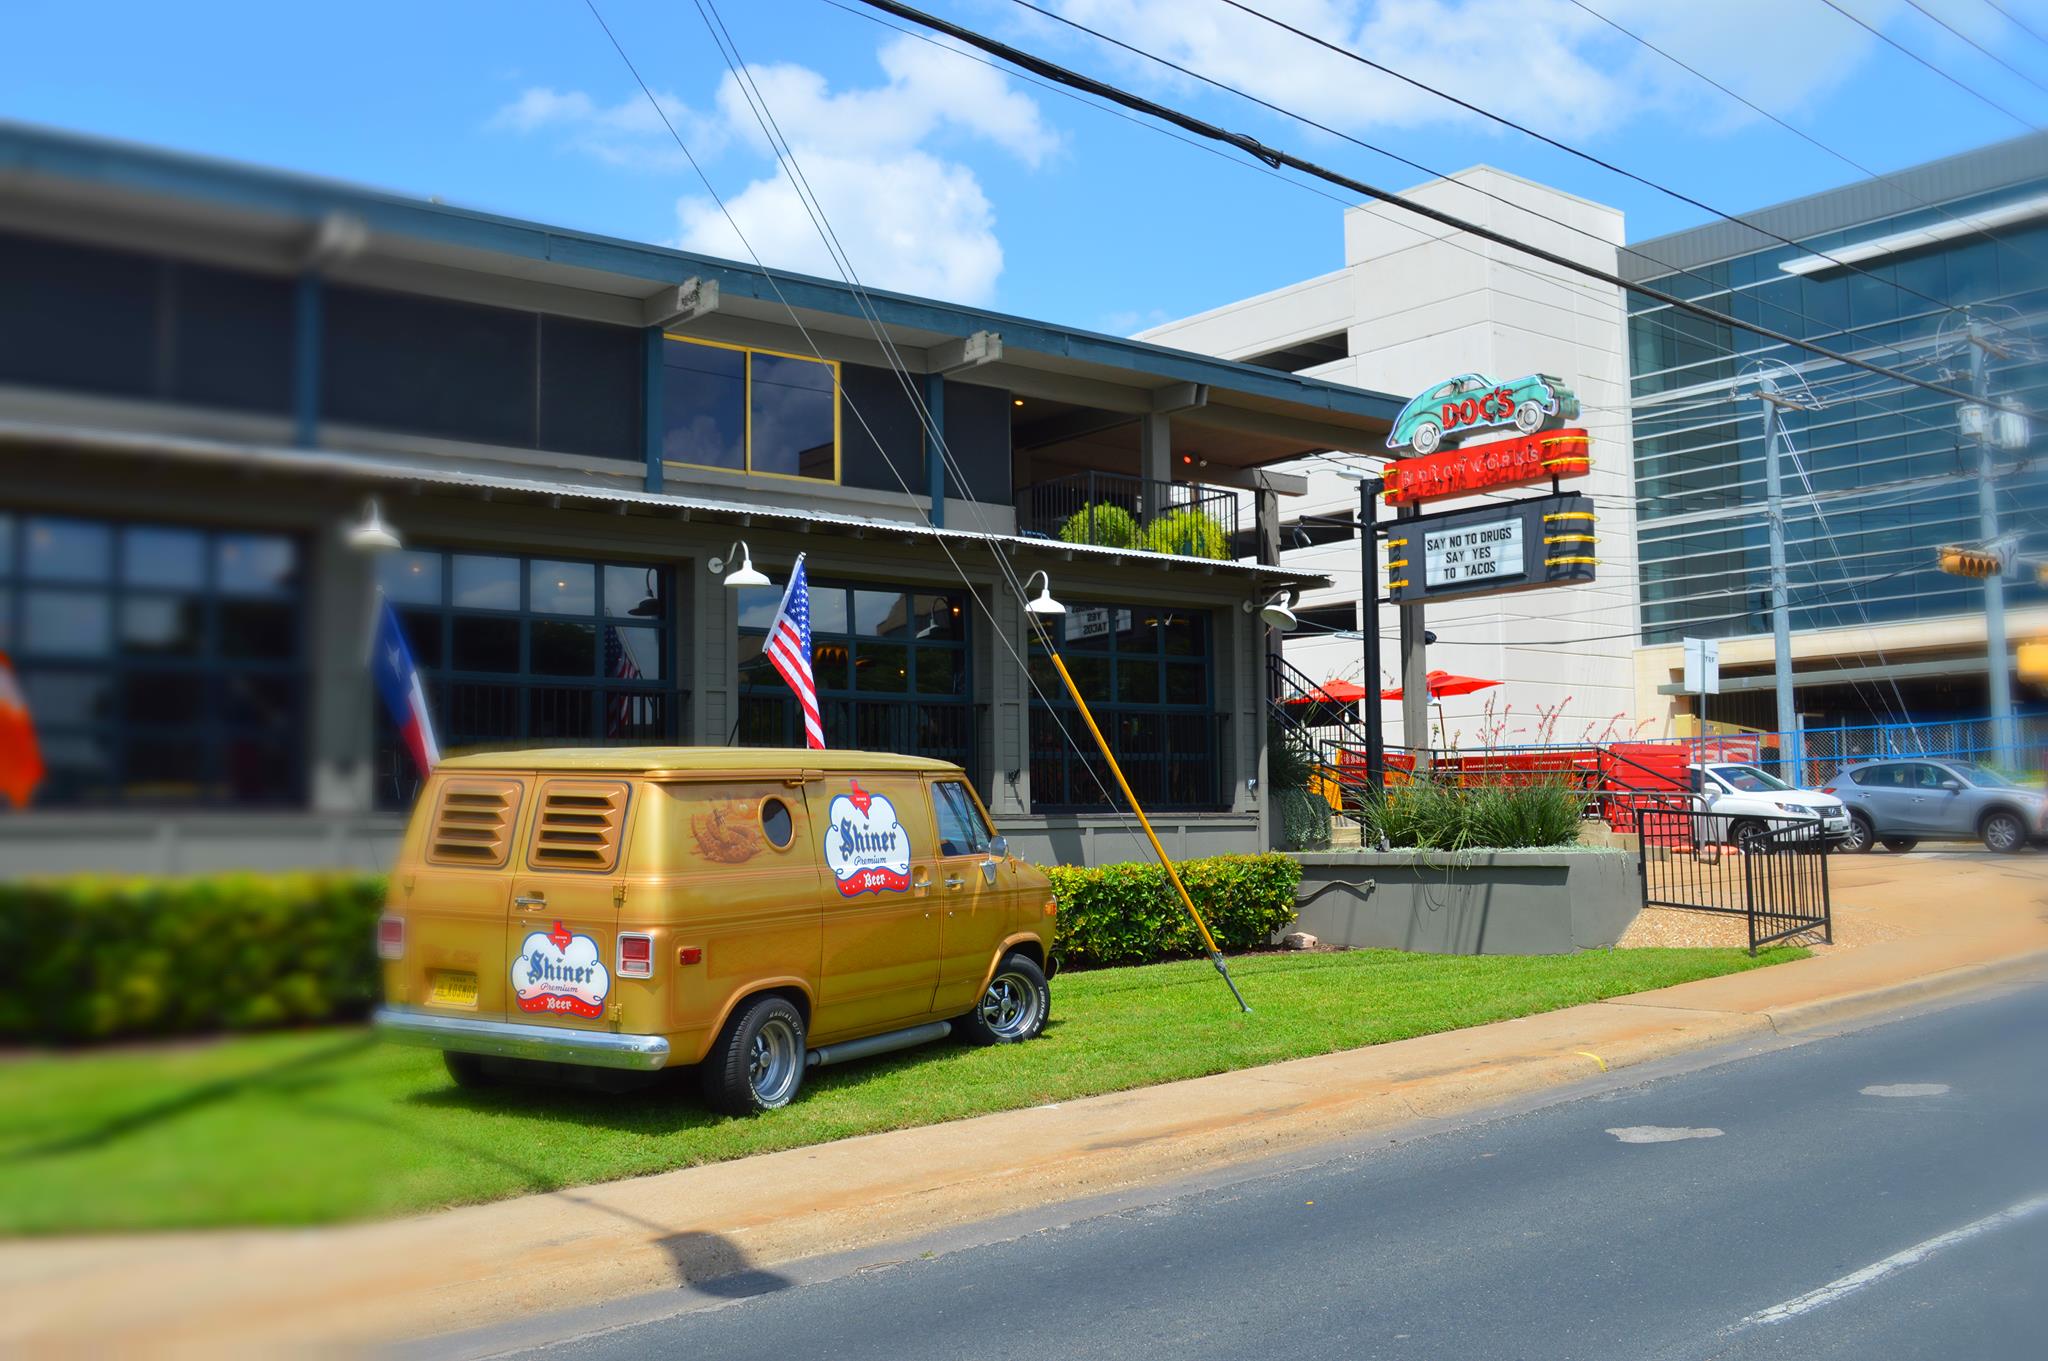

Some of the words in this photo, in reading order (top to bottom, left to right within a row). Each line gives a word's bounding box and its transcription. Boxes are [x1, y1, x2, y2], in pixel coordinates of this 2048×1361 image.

[1442, 387, 1515, 430] DOC'S
[1427, 538, 1446, 551] SAY
[1449, 535, 1462, 548] NO
[1465, 532, 1477, 545] TO
[1480, 527, 1512, 543] DRUGS
[1446, 551, 1465, 563] SAY
[1472, 546, 1491, 559] YES
[1444, 567, 1456, 579] TO
[1465, 561, 1496, 576] TACOS
[839, 817, 896, 862] Shiner
[854, 856, 886, 866] Premium
[863, 873, 885, 887] Beer
[527, 949, 594, 985] Shiner
[540, 982, 579, 993] Premium
[547, 997, 572, 1010] Beer
